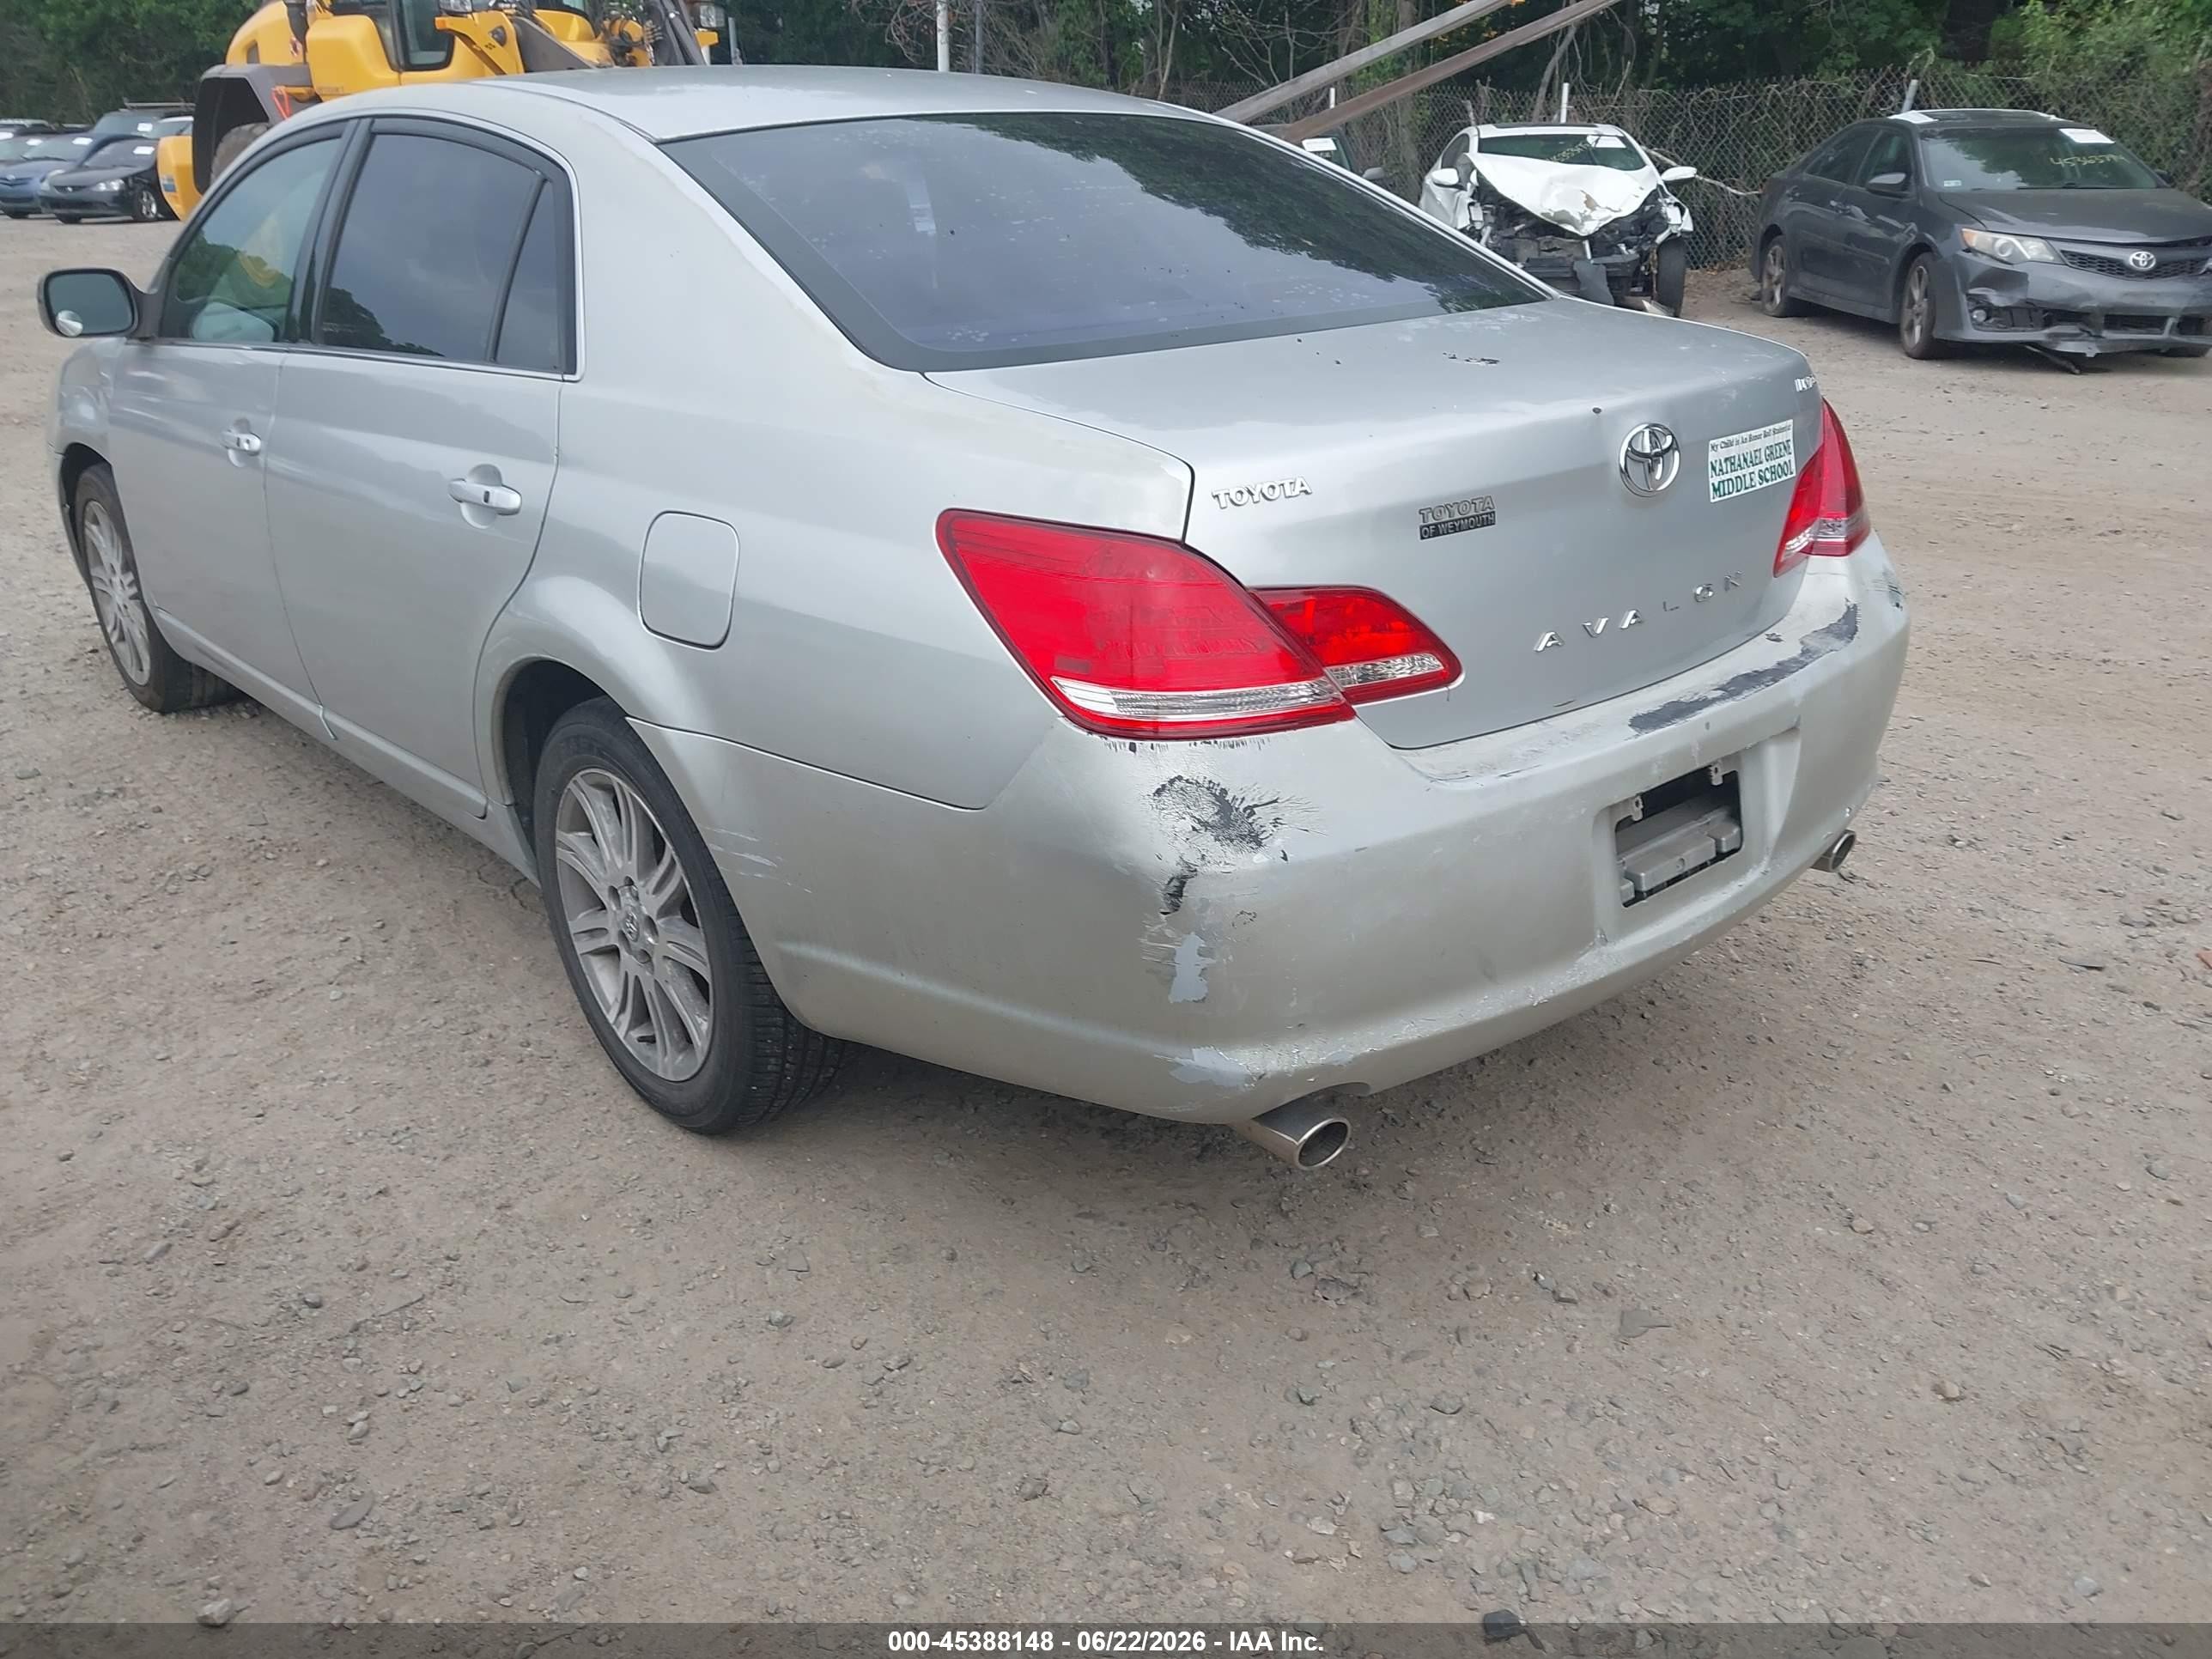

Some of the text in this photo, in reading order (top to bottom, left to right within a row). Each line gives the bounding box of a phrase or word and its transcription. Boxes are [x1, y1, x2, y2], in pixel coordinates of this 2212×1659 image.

[1711, 440, 1792, 478] NATHANAEL GREENE
[1212, 476, 1313, 509] TOYOTA
[1711, 459, 1794, 500] MIDDLE SCHOOL
[1419, 495, 1495, 523] TOYOTA
[1421, 513, 1495, 538] OF WEYMOUTH
[1534, 570, 1743, 652] AVALON
